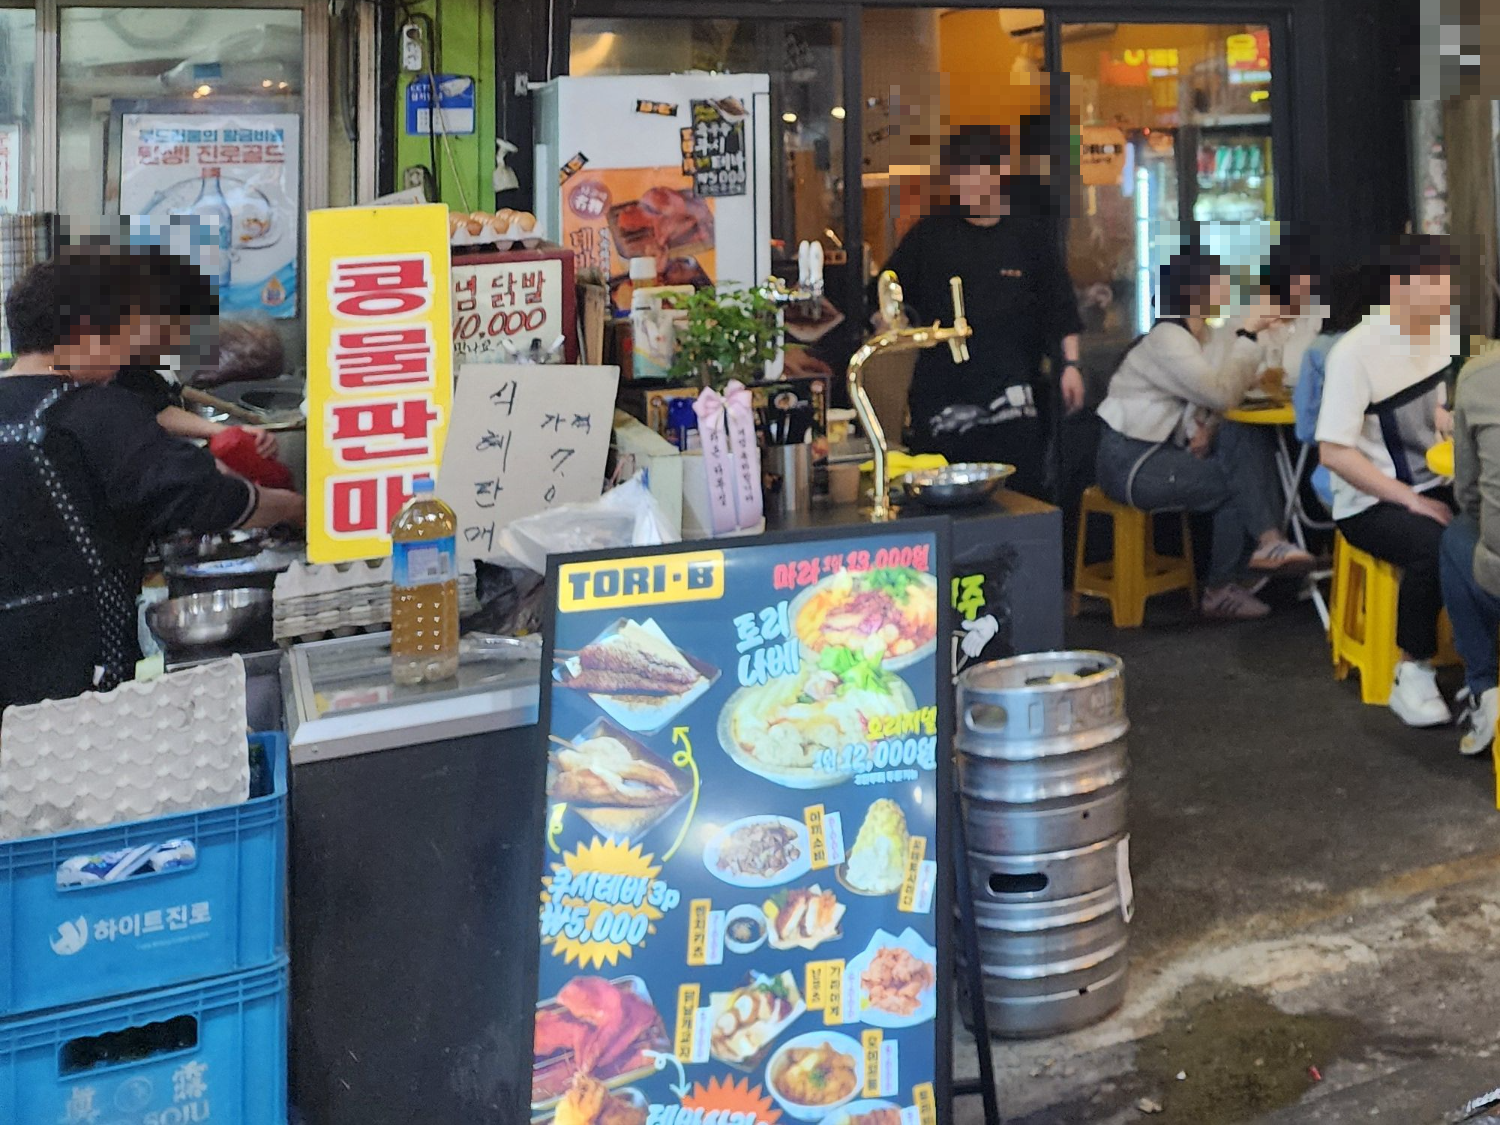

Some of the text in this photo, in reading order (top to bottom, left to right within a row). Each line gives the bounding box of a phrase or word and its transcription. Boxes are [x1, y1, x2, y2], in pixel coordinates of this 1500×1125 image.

[197, 144, 285, 164] 진로골드
[331, 257, 438, 535] 콩물판매
[773, 558, 820, 590] 마라
[733, 600, 792, 654] 토리
[738, 642, 802, 687] 나베
[866, 706, 937, 741] 오리지널
[841, 736, 937, 774] 12,000원
[548, 866, 680, 912] 쿠시테바 3p
[94, 901, 212, 942] 하이트진로
